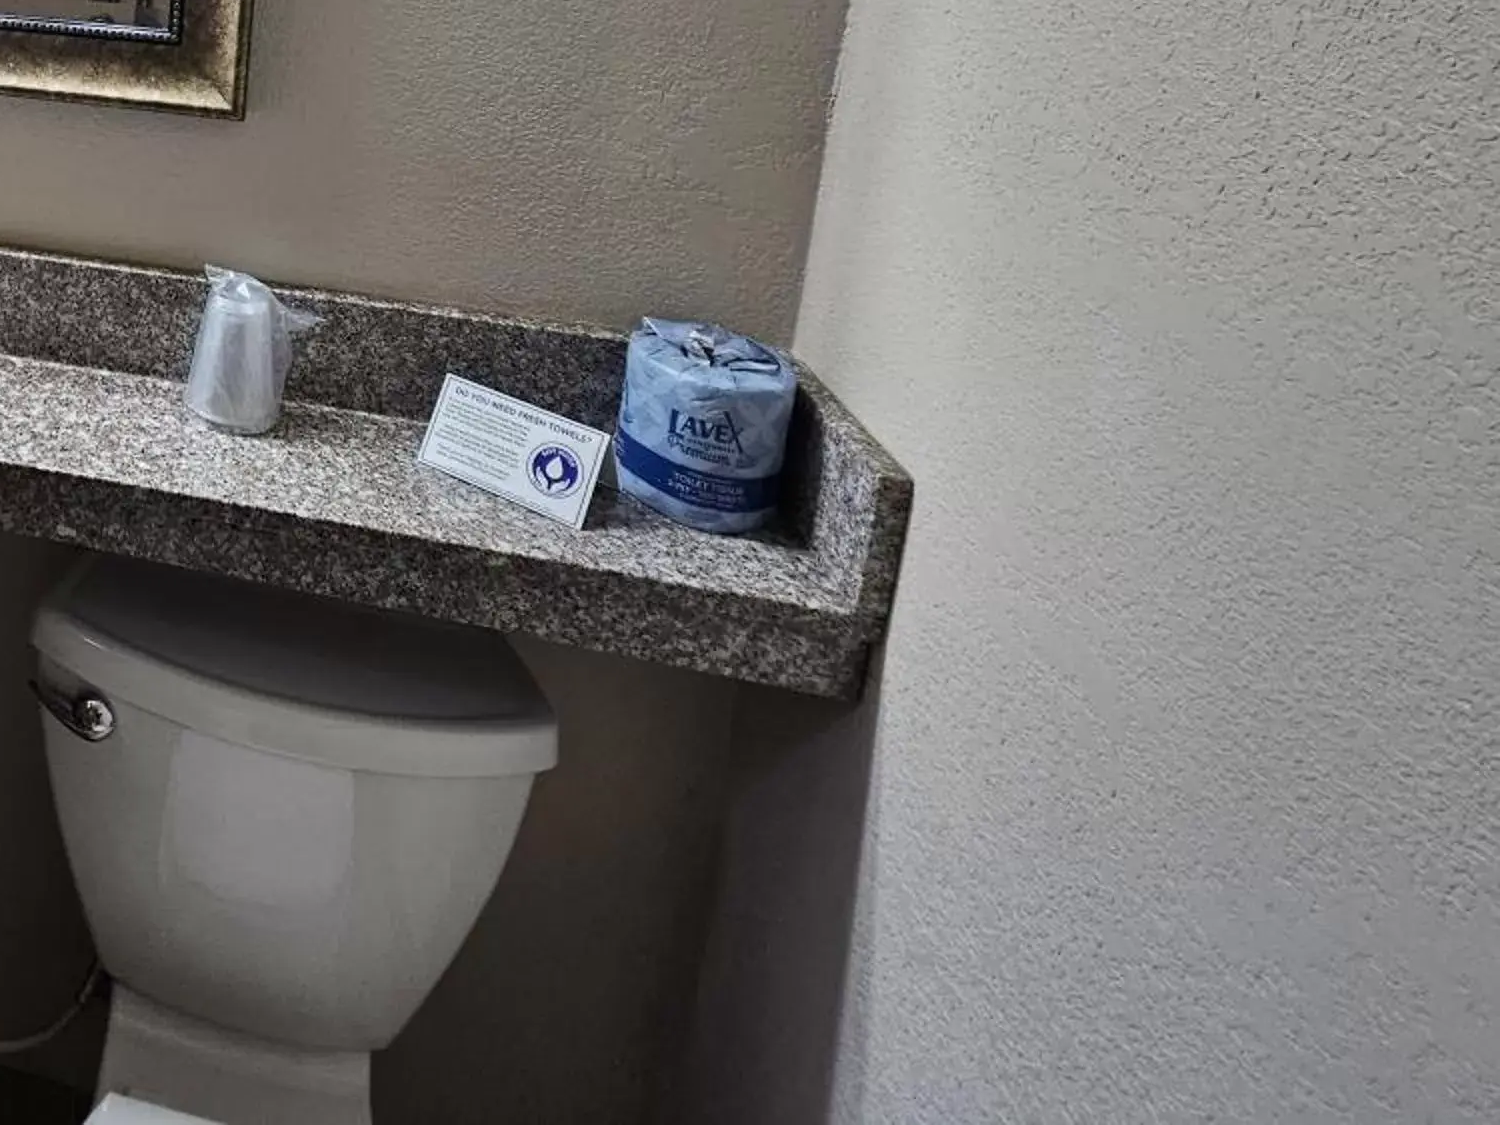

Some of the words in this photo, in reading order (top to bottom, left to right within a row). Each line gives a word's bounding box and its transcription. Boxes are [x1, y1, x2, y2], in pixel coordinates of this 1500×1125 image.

[456, 386, 469, 398] DO
[472, 393, 491, 406] YOU
[491, 401, 516, 417] NEED
[518, 410, 547, 427] FRESH
[549, 421, 593, 443] TOWELS?
[668, 408, 744, 454] LAVEX
